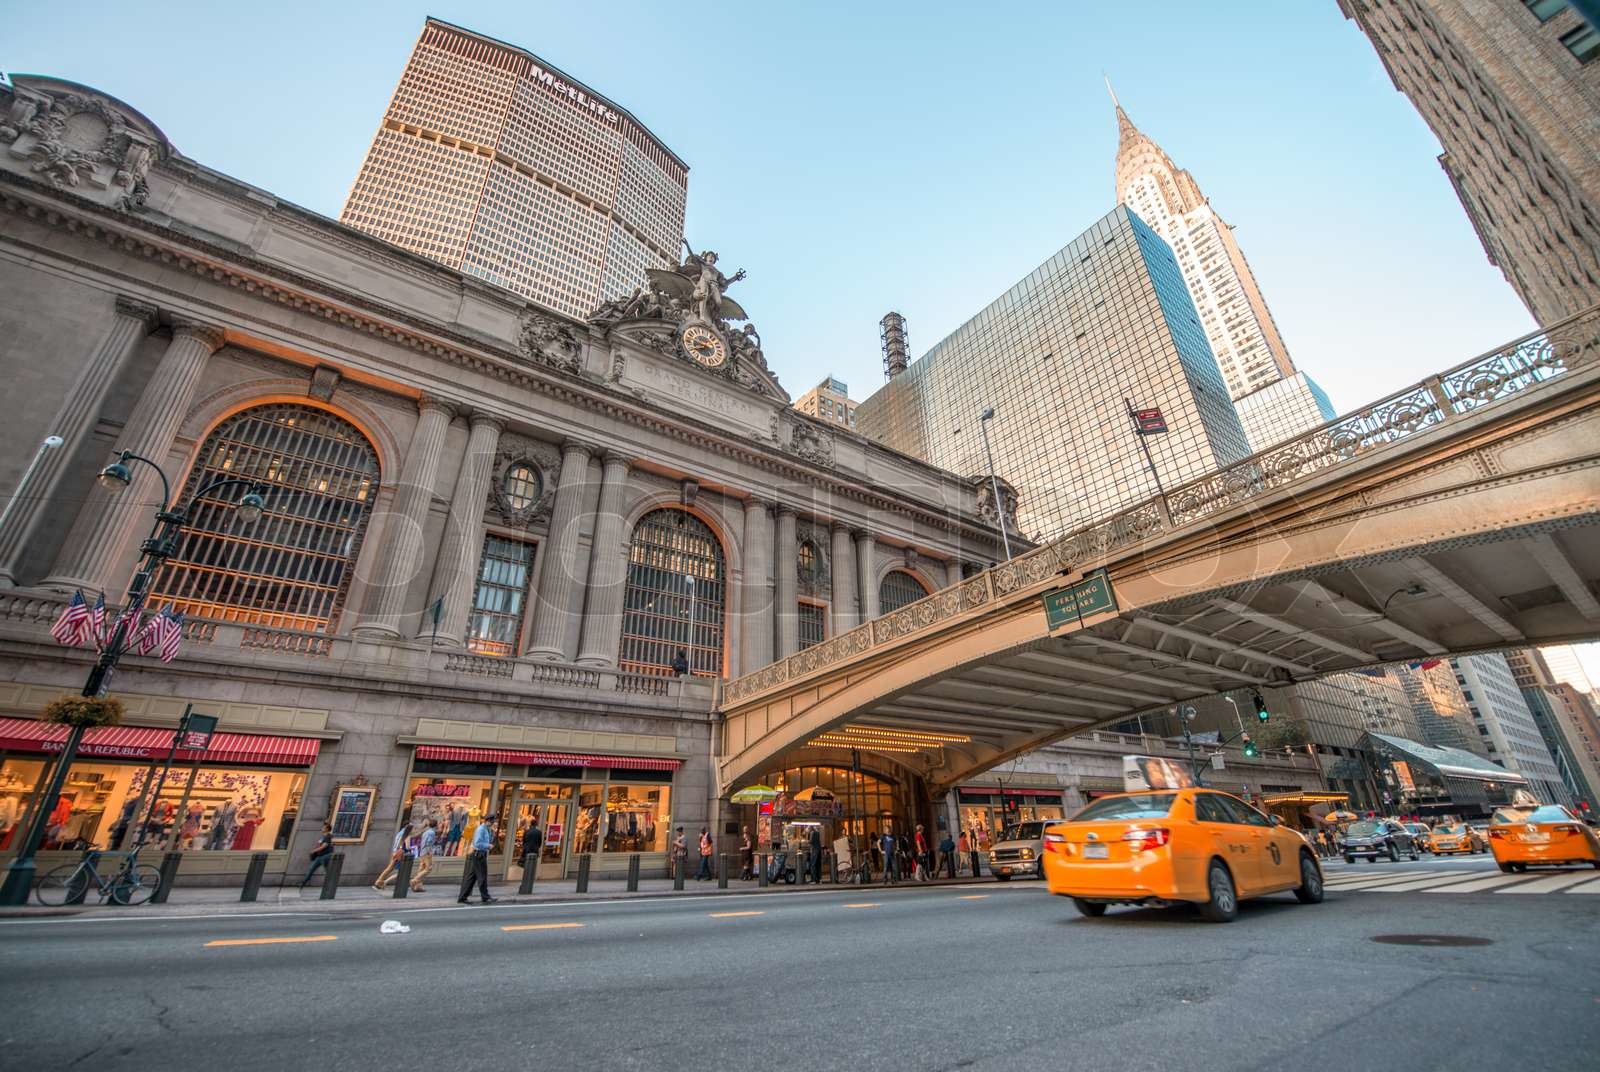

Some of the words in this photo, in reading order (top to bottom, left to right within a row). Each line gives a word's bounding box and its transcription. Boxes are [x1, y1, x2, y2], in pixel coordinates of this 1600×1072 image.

[531, 64, 617, 123] MetLife
[41, 741, 92, 753] BANNA
[94, 745, 150, 756] REPUBLIC
[533, 757, 560, 766] BANANA
[560, 758, 591, 767] REPUBLIC
